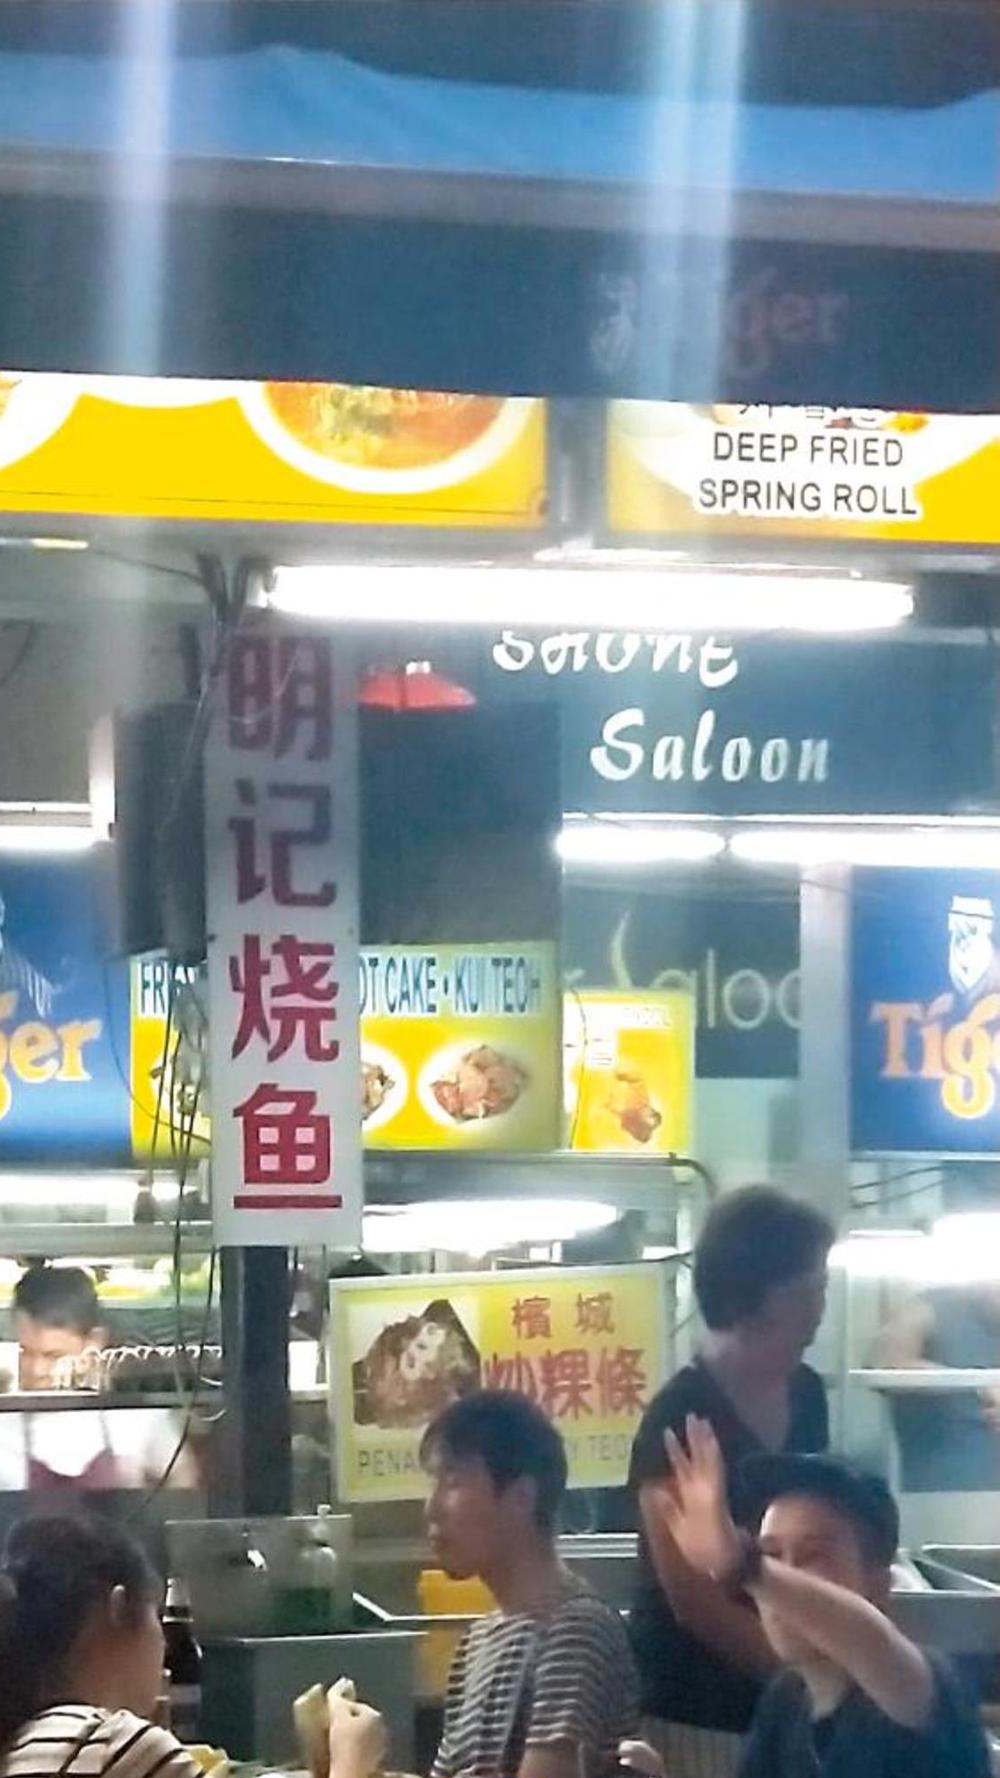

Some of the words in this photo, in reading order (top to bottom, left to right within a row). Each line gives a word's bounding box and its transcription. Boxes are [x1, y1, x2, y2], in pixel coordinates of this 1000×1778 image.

[714, 432, 798, 463] DEEP
[810, 436, 904, 466] FRIED
[699, 478, 822, 511] SPRING
[834, 485, 917, 515] ROLL
[590, 708, 828, 781] Saloon
[228, 636, 343, 1209] 明记烧鱼
[385, 957, 437, 1013] CAKE
